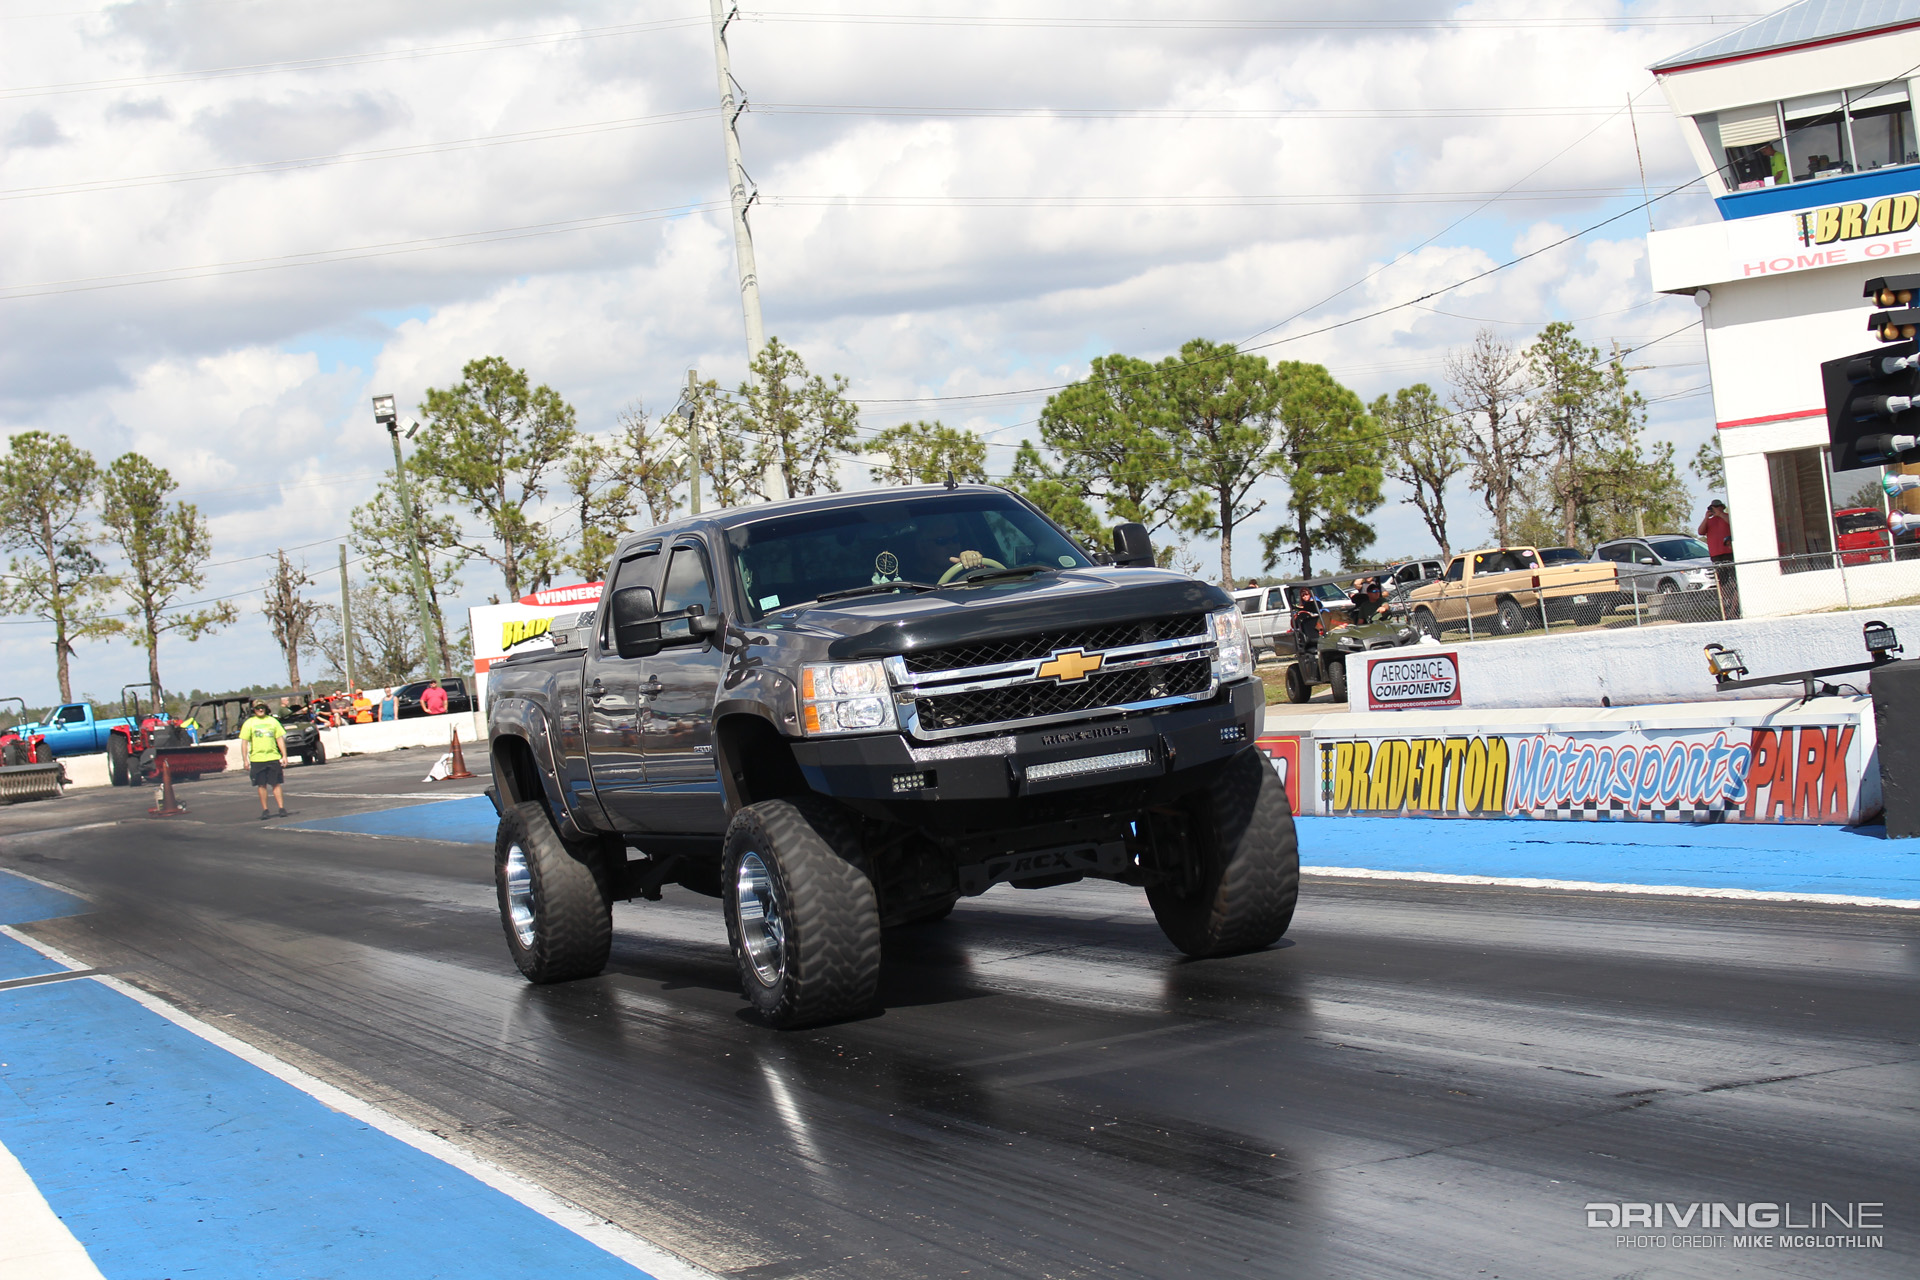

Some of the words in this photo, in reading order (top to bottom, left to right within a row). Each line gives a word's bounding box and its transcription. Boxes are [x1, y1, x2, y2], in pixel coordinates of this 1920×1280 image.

[1743, 249, 1848, 277] HOME
[1864, 239, 1913, 257] OF
[535, 585, 604, 605] WINNERS
[1381, 661, 1444, 682] AEROSPACE
[1375, 681, 1452, 698] COMPONENTS
[1370, 699, 1461, 709] www.aerospacecomponents.com
[1333, 735, 1510, 816] BRADENTON
[1506, 732, 1751, 816] Motorsports
[1746, 725, 1855, 818] PARK
[1014, 851, 1072, 872] RCX
